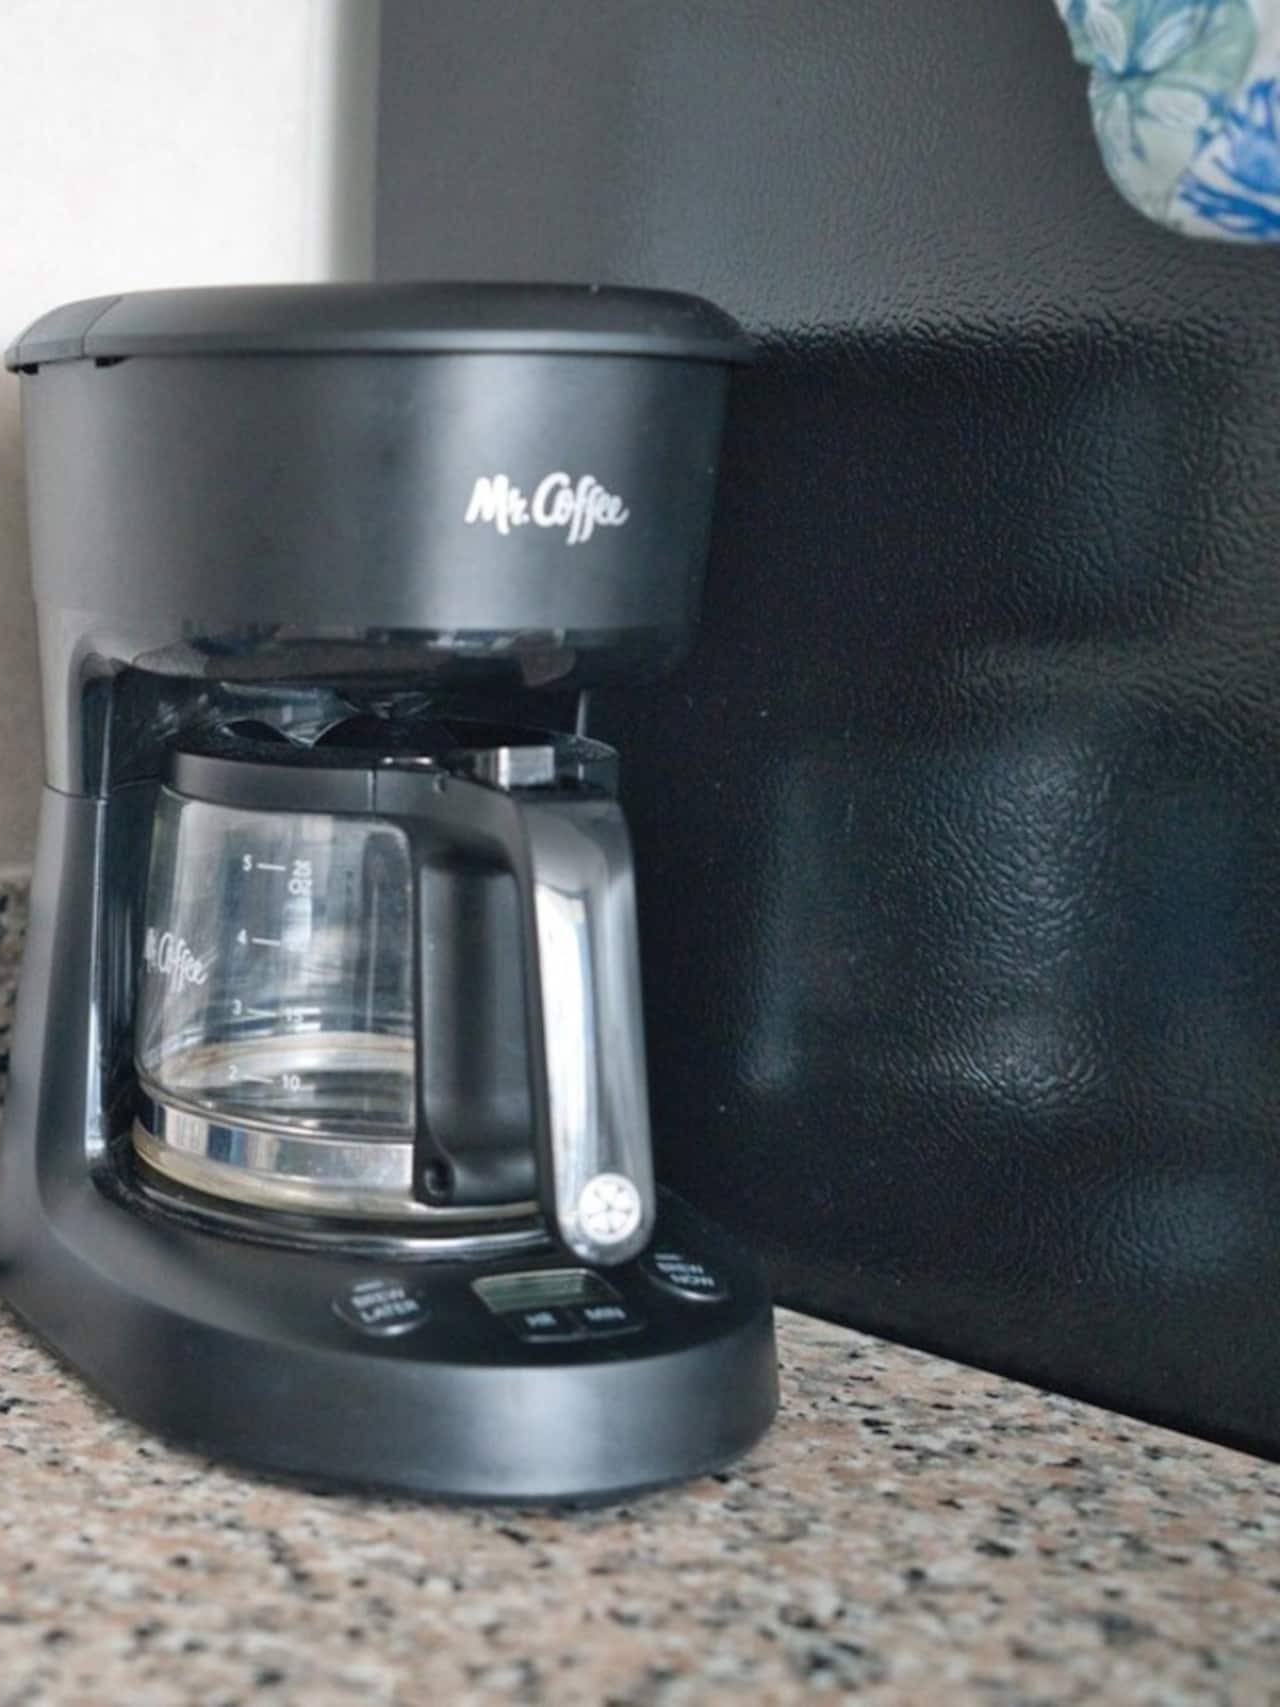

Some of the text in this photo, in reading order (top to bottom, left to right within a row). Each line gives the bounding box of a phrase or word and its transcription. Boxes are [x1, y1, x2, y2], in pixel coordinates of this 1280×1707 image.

[464, 472, 629, 545] Mr. Coffee
[242, 853, 253, 872] 5
[236, 928, 248, 945] 4
[231, 998, 242, 1016] 3
[281, 1072, 301, 1091] 10
[360, 1299, 419, 1323] LATER
